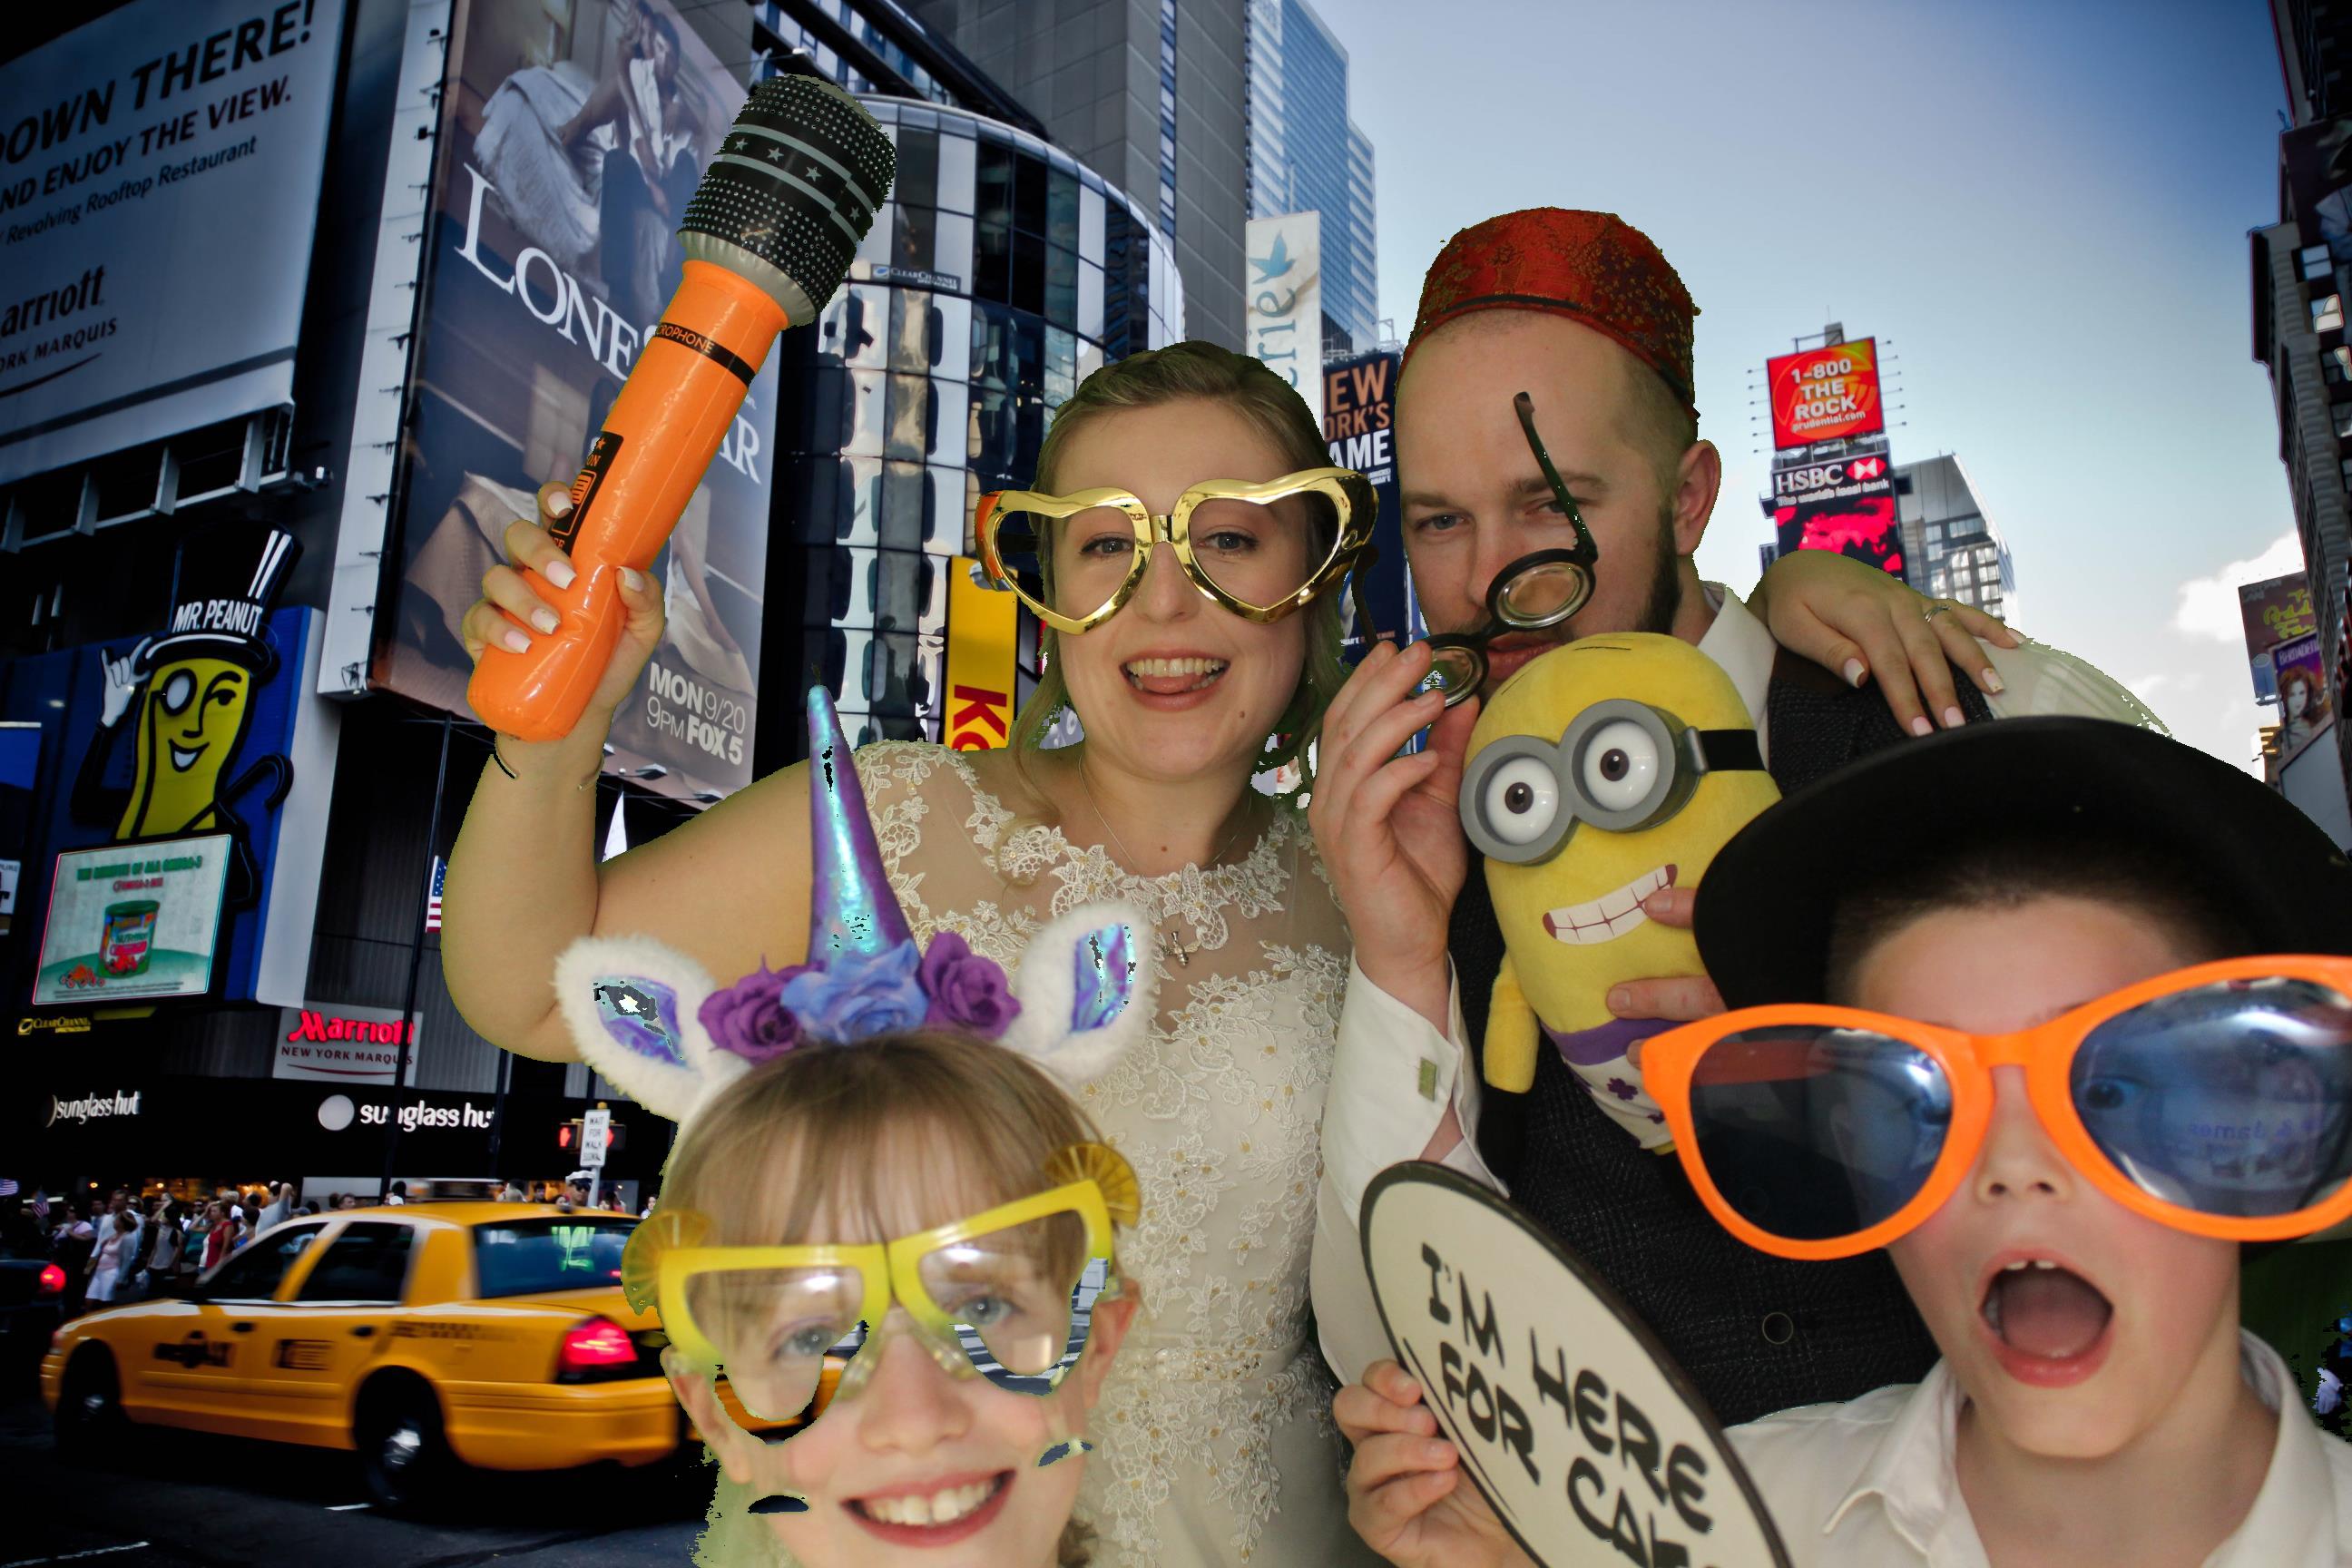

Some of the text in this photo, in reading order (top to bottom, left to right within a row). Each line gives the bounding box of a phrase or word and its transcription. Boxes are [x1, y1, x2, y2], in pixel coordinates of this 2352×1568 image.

[131, 0, 314, 111] THERE!
[0, 74, 292, 215] ND ENJOY THE VIEW.
[6, 135, 257, 245] Revolving Rooftop Restaurant
[0, 264, 105, 338] arriott
[34, 318, 118, 360] MARQUIS
[1791, 358, 1852, 384] 1-800
[1801, 378, 1846, 401] THE
[1323, 402, 1391, 443] ORK'S
[1791, 410, 1867, 434] prudential.com
[1794, 395, 1857, 420] ROCK
[1329, 428, 1391, 472] AME
[1776, 464, 1844, 494] HSBC
[172, 599, 263, 637] MR. PEANUT
[650, 662, 746, 734] MON 9/20
[647, 696, 744, 766] 9PM FOX 5
[281, 1045, 413, 1064] NEW YORK MARQUS
[56, 1090, 141, 1125] sunglass hut
[463, 1102, 495, 1129] hu
[1421, 1242, 1714, 1535] I'M HERE
[1439, 1340, 1716, 1568] FOR CAK
